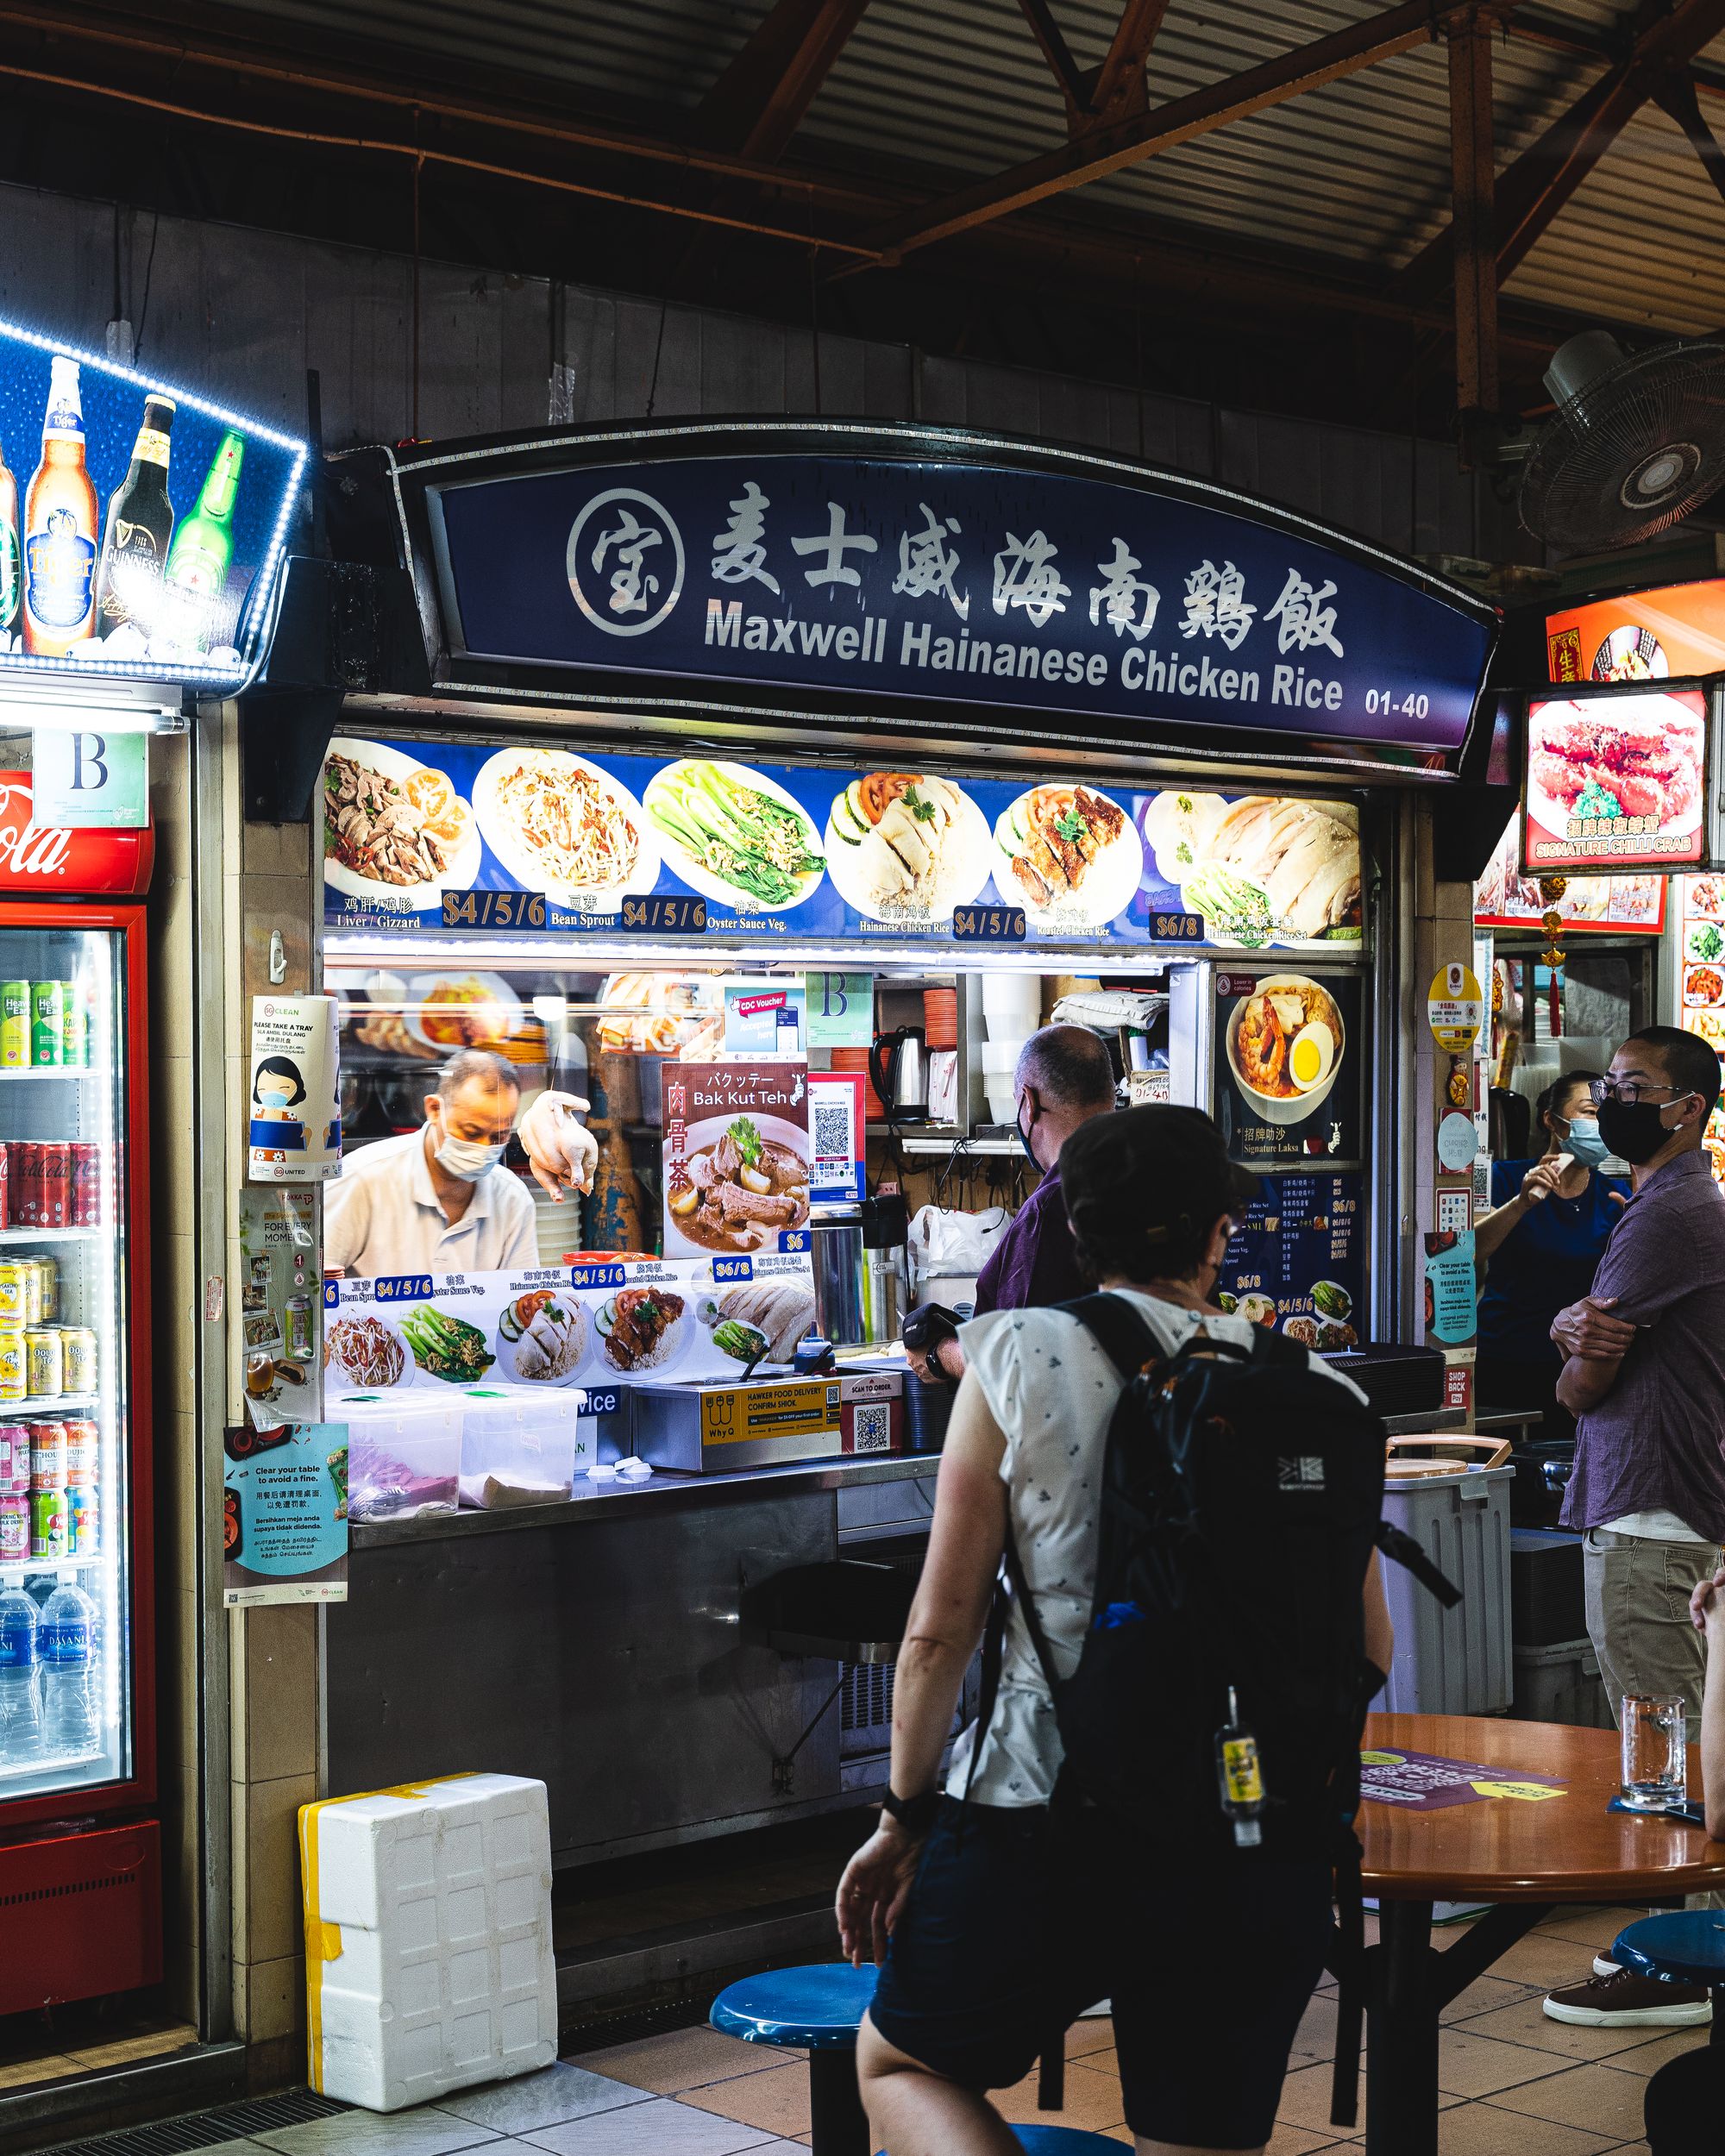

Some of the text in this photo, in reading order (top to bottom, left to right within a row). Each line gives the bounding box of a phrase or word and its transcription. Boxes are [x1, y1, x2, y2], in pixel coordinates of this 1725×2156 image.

[53, 412, 78, 429] Tiger
[105, 544, 160, 575] GUINNESS
[29, 546, 94, 588] Tiger
[705, 598, 1343, 711] Maxwell Hainanese Chicken Rice
[1365, 688, 1429, 719] 01-40
[69, 733, 108, 789] B
[1535, 836, 1692, 858] SIGNATURE CHILLI CRAB
[568, 893, 598, 912] 豆芽
[734, 899, 759, 916] 油菜
[878, 905, 931, 919] 海南鸡饭
[337, 914, 367, 928] Liver
[376, 915, 421, 929] Gizzard
[551, 912, 615, 929] Bean Sprout
[707, 918, 787, 932] Oyster Sauce Veg.
[859, 920, 950, 933] Hainanese Chicken Rice
[1156, 915, 1198, 937] $6/8
[1037, 924, 1110, 937] Roasted Chicken Rice
[1206, 928, 1308, 941] Hainanese Chicken Rice Set
[821, 972, 849, 1017] B
[741, 996, 783, 1012] CDC Voucher
[739, 1018, 774, 1033] Accepted
[757, 1029, 775, 1041] here
[707, 1072, 774, 1088] バクッテー
[693, 1091, 787, 1106] Bak Kut Teh
[668, 1081, 689, 1192] 肉骨茶
[1244, 1127, 1287, 1142] 招牌叻沙
[1244, 1143, 1299, 1155] Signature Laksa
[1333, 1200, 1356, 1213] $6/8
[264, 1222, 283, 1232] FOR
[787, 1232, 804, 1250] $6
[524, 1269, 561, 1281] 海南鸡饭
[715, 1260, 750, 1276] $6/8
[445, 1274, 465, 1286] 油菜
[510, 1280, 573, 1290] Hainanese Chicken Ric
[643, 1274, 664, 1283] Chicken
[665, 1273, 679, 1282] Rice
[1237, 1275, 1261, 1289] $6/8
[351, 1280, 372, 1292] 豆芽
[433, 1284, 486, 1298] yster Sauce Veg.
[340, 1292, 376, 1303] Bean Spro
[1277, 1297, 1314, 1314] $4/5/6
[1448, 1372, 1465, 1382] SHOP
[747, 1387, 823, 1401] HAWKER FOOD DELIVERY.
[1448, 1382, 1465, 1392] BACK
[748, 1400, 798, 1411] CONFIRM SHIOK.
[1452, 1395, 1462, 1403] Pay
[255, 1516, 286, 1525] Bersihkan
[49, 1633, 85, 1646] DASANI
